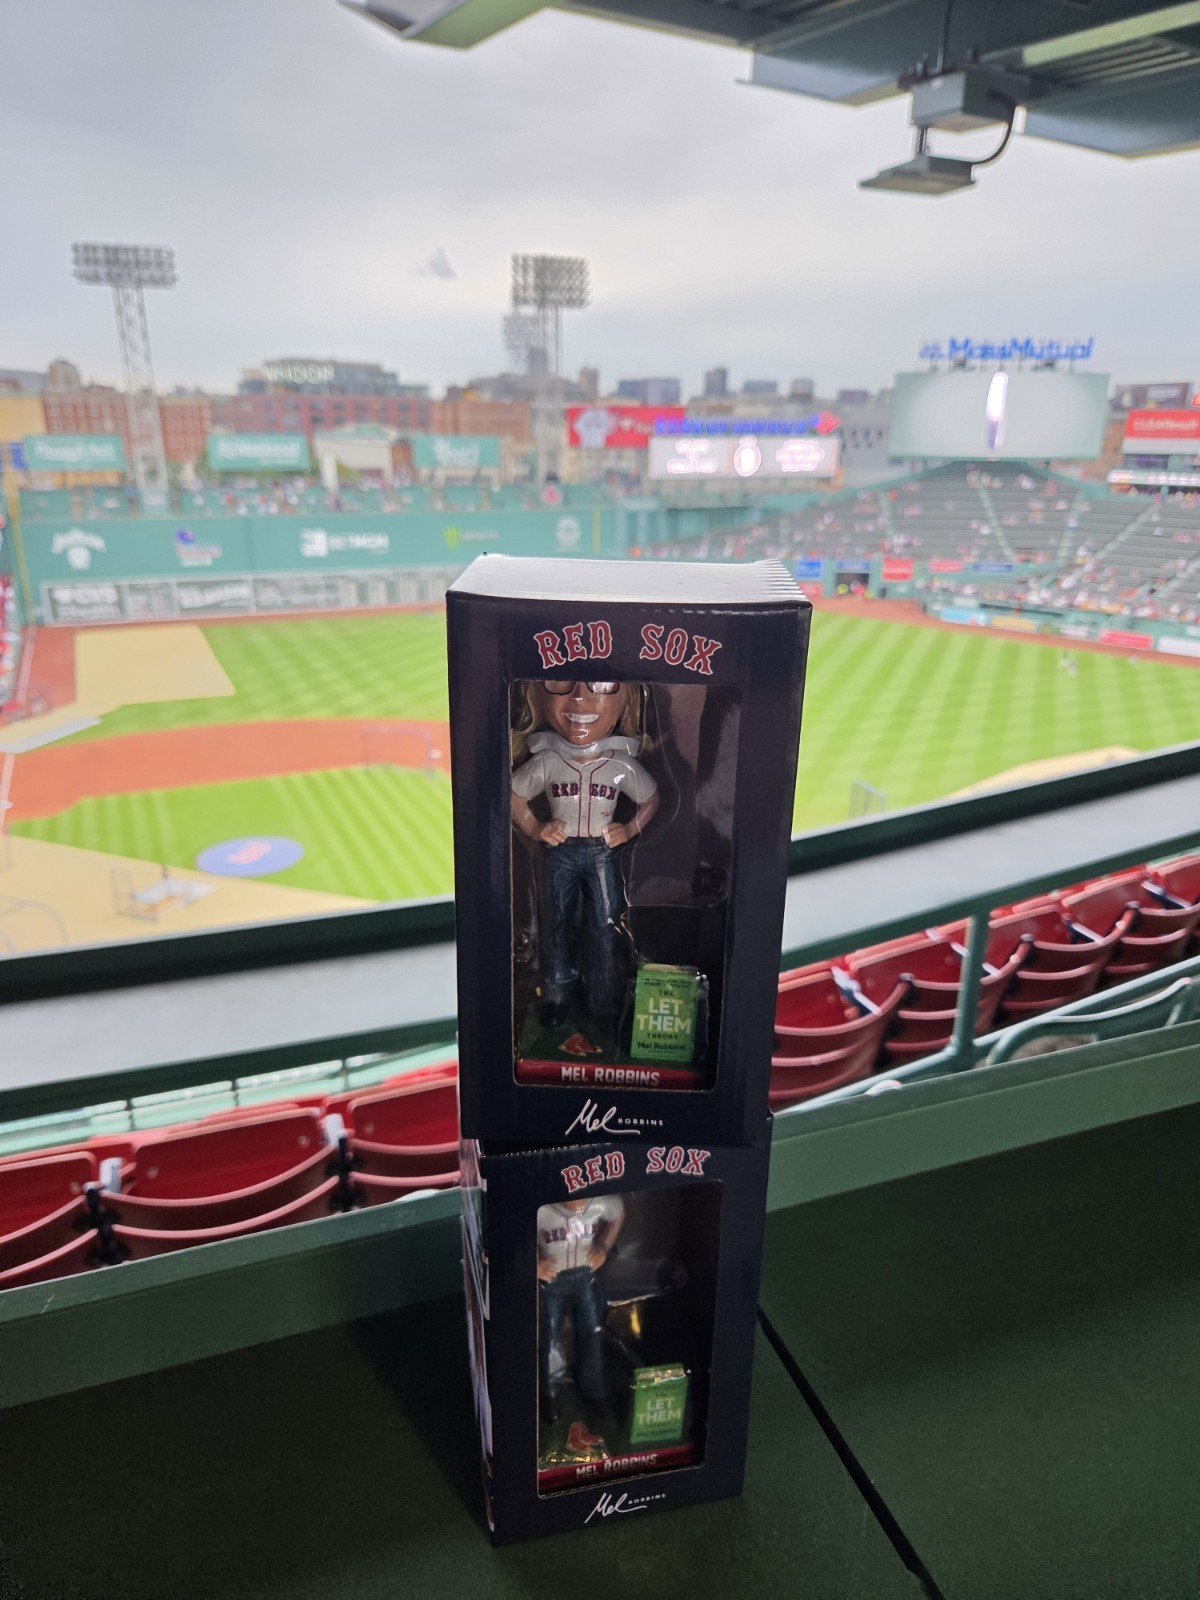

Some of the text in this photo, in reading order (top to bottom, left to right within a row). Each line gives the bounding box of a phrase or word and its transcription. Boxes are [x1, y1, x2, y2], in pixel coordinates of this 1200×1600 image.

[948, 336, 1096, 360] MassMutual
[533, 620, 723, 675] RED SOX
[551, 783, 617, 800] RED SOX
[648, 998, 683, 1015] LET
[636, 1014, 692, 1034] THEM
[637, 1041, 687, 1051] Mel Robbins
[561, 1066, 661, 1087] MEL ROBBINS
[564, 1098, 664, 1136] Mel ROBBINS
[560, 1146, 711, 1194] RED SOX
[647, 1397, 676, 1411] LET
[636, 1408, 682, 1425] THEM
[575, 1453, 658, 1479] MEL ROBBINS
[584, 1492, 667, 1524] Mel ROBBINS
